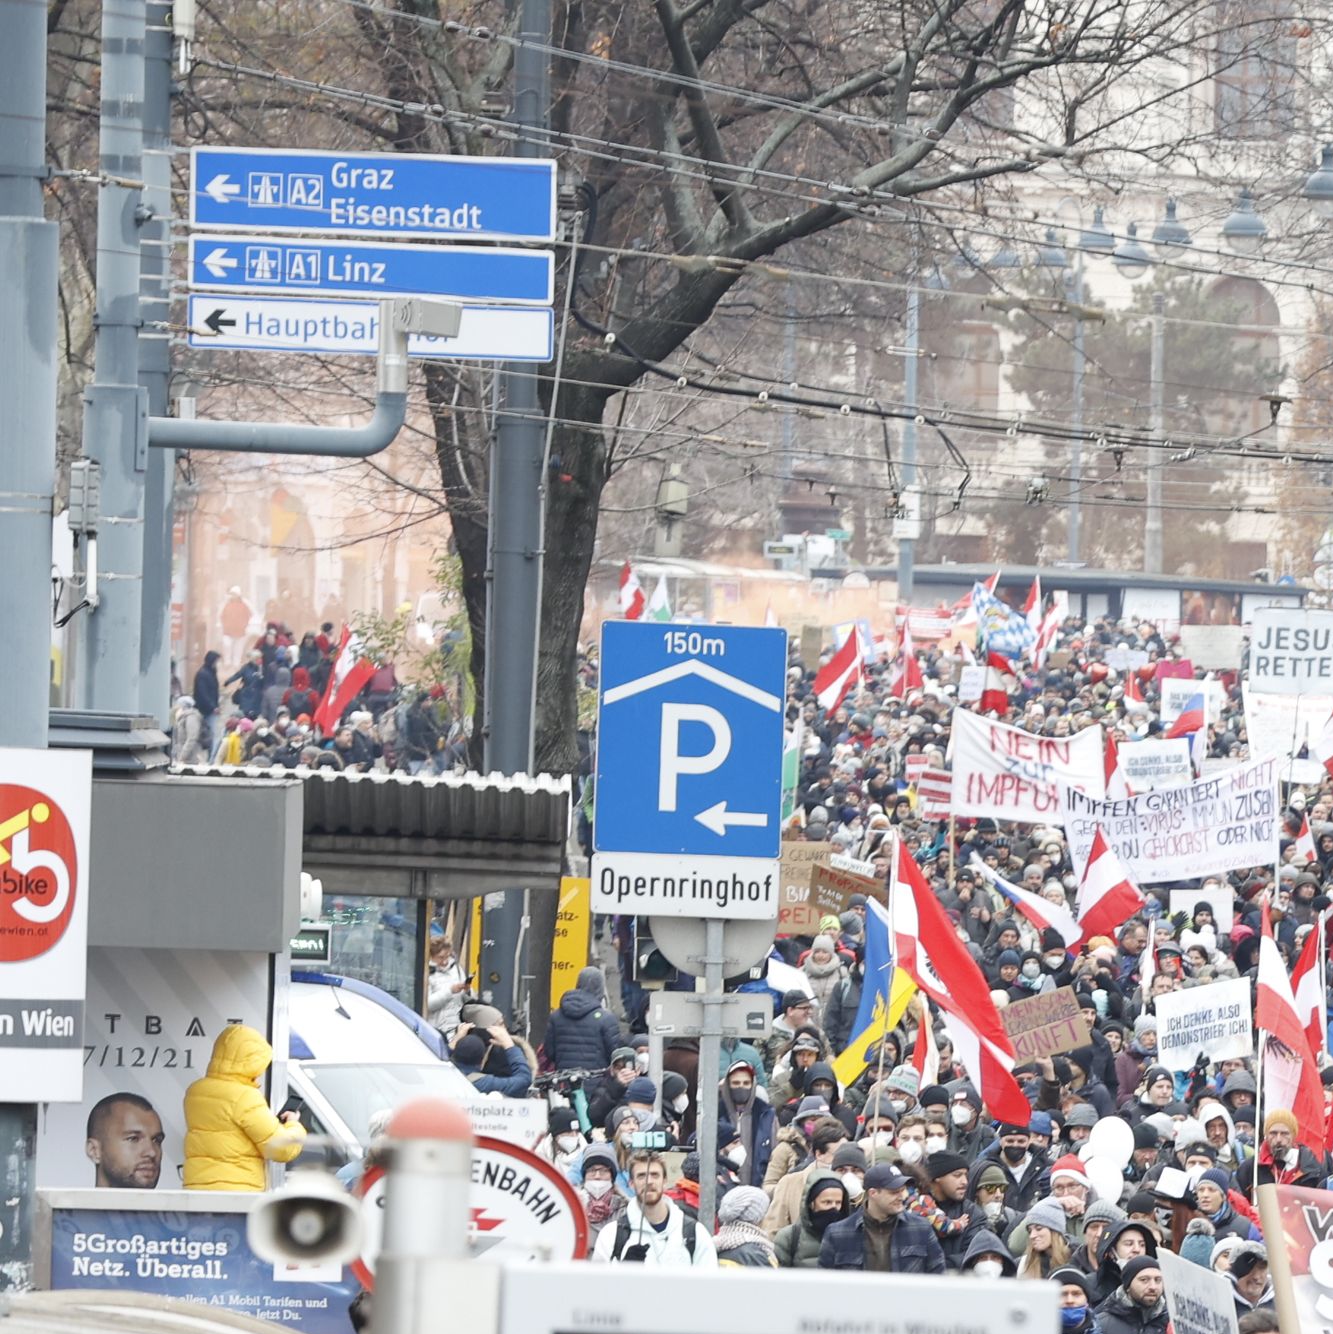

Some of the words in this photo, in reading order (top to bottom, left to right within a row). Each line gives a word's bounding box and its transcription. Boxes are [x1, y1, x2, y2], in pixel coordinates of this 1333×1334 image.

[331, 162, 394, 191] Graz
[291, 178, 320, 206] A2
[331, 198, 482, 230] Eisenstadt
[290, 254, 318, 279] A1
[328, 254, 386, 284] Linz
[664, 631, 725, 656] 150m
[658, 702, 732, 812] P
[990, 725, 1070, 765] NEIN
[1067, 786, 1138, 817] IMPFEN
[1230, 760, 1275, 791] NICHT
[1216, 826, 1248, 846] ODER
[0, 870, 48, 895] bike
[600, 867, 773, 906] Opernringhof
[0, 926, 48, 936] ewien.at
[0, 1012, 14, 1035] n
[21, 1009, 73, 1037] Wien
[1167, 1016, 1182, 1032] ICH
[1217, 1004, 1241, 1020] ALSO
[1229, 1018, 1248, 1035] ICH!
[1014, 1016, 1079, 1060] KUNFT
[471, 1159, 561, 1226] ENBAHN
[72, 1234, 228, 1257] 5Großartiges
[72, 1256, 130, 1277] Netz.
[136, 1254, 228, 1280] Überall.
[211, 1295, 225, 1306] A1
[229, 1294, 261, 1307] Mobil
[262, 1295, 303, 1308] Tarifen
[305, 1297, 328, 1309] und
